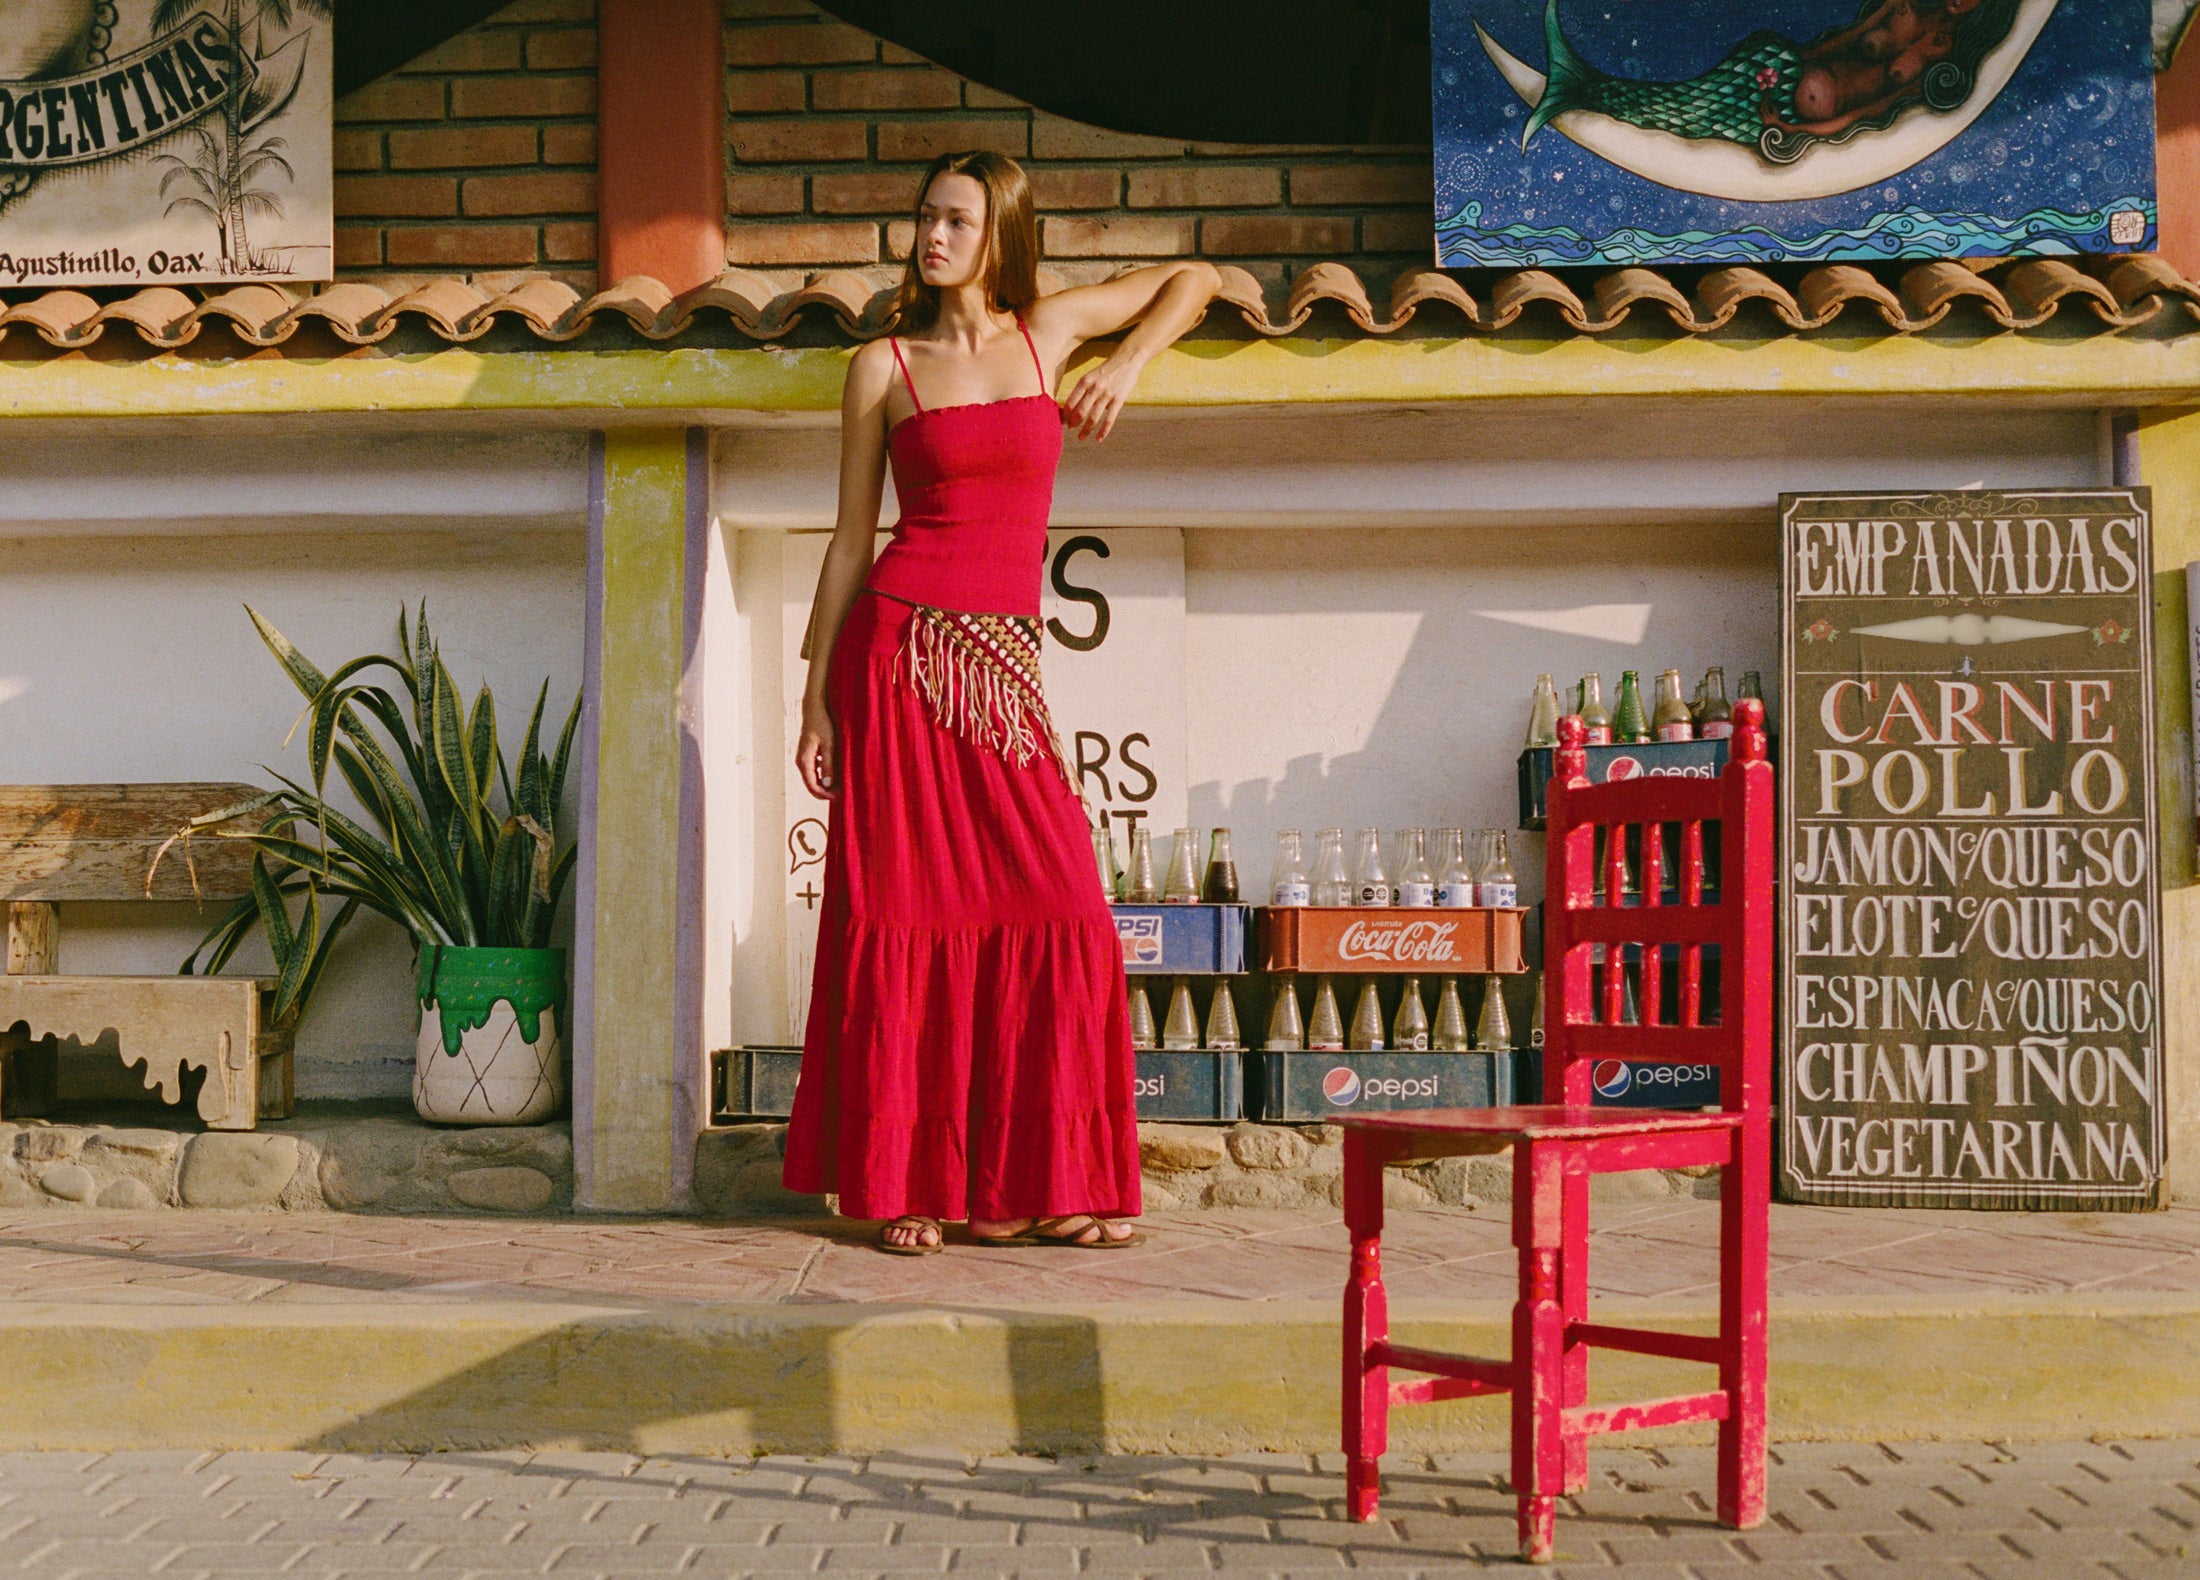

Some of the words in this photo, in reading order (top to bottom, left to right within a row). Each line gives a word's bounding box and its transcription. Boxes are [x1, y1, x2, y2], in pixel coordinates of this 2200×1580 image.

[1796, 518, 2138, 596] EMPANADAS
[1043, 535, 1110, 652] S
[1820, 679, 2116, 745] CARNE
[1814, 747, 2128, 817] POLLO
[1794, 826, 1961, 886] JAMON
[1115, 918, 1159, 937] PSI
[1338, 920, 1459, 962] Coca-Cola
[1794, 894, 1958, 958] ELOTE
[1795, 974, 2005, 1031] ESPINACA
[1364, 1074, 1439, 1101] pepsi
[1636, 1064, 1711, 1089] pepsi
[1796, 1036, 2153, 1107] CHAMPIÑON
[1795, 1116, 2149, 1181] VEGETARIANA
